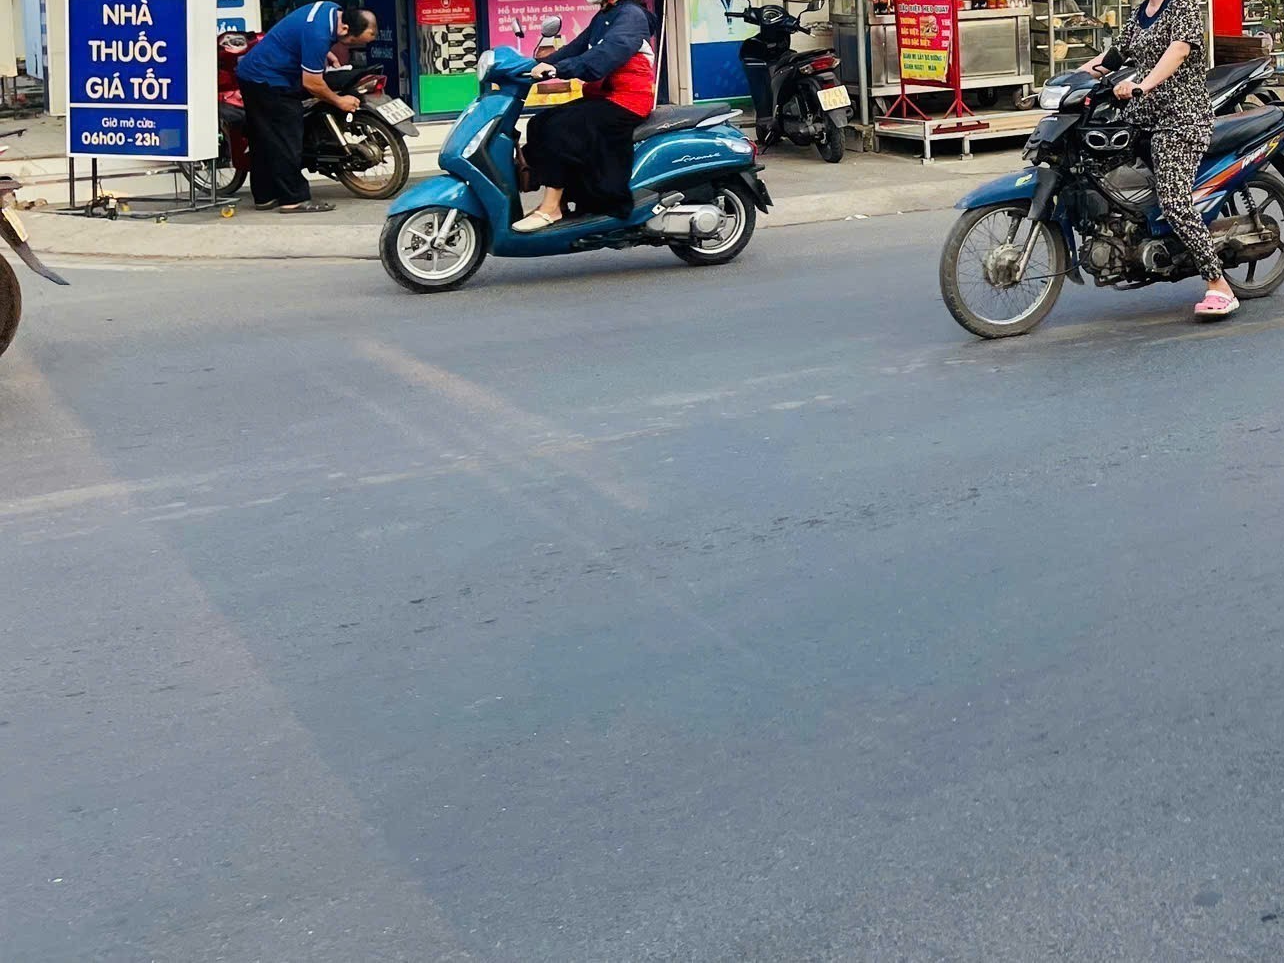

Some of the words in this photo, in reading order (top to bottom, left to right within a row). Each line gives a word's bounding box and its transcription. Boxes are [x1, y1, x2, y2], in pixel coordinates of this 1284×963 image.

[88, 31, 168, 64] THUỐC
[85, 72, 125, 100] GIÁ
[130, 68, 171, 101] TỐT
[102, 116, 118, 129] Giờ
[120, 117, 134, 129] mở
[136, 118, 156, 130] cửa:
[81, 131, 126, 146] 06h00
[135, 132, 160, 146] 23h
